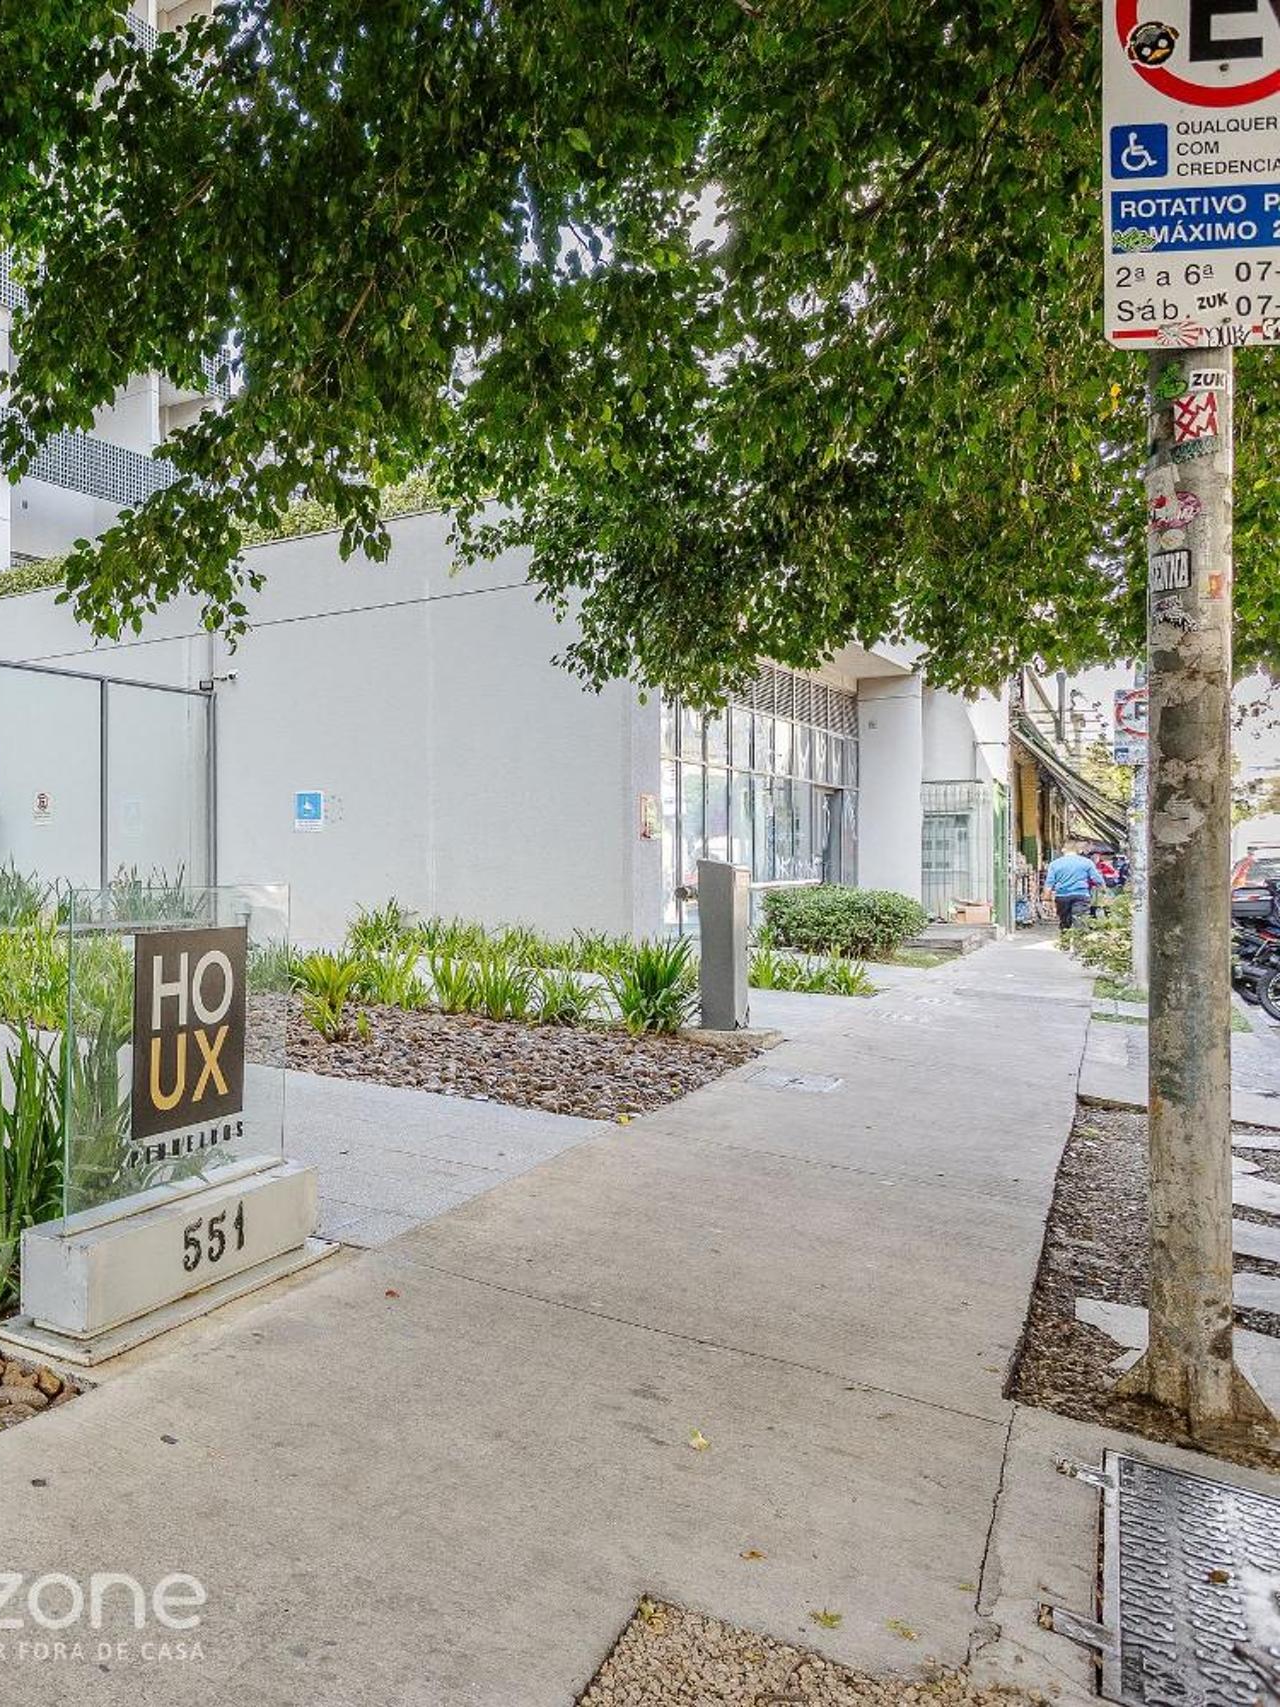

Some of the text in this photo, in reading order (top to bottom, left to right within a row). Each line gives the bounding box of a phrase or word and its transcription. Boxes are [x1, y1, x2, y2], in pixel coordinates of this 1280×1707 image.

[1176, 116, 1278, 135] QUALQUER
[1176, 141, 1219, 156] COM
[1120, 194, 1247, 218] ROTATIVO
[1149, 220, 1257, 243] MÁXIMO
[1156, 270, 1170, 286] a
[1197, 292, 1228, 310] ZUK
[1192, 373, 1224, 386] ZUK
[182, 1201, 246, 1273] 551
